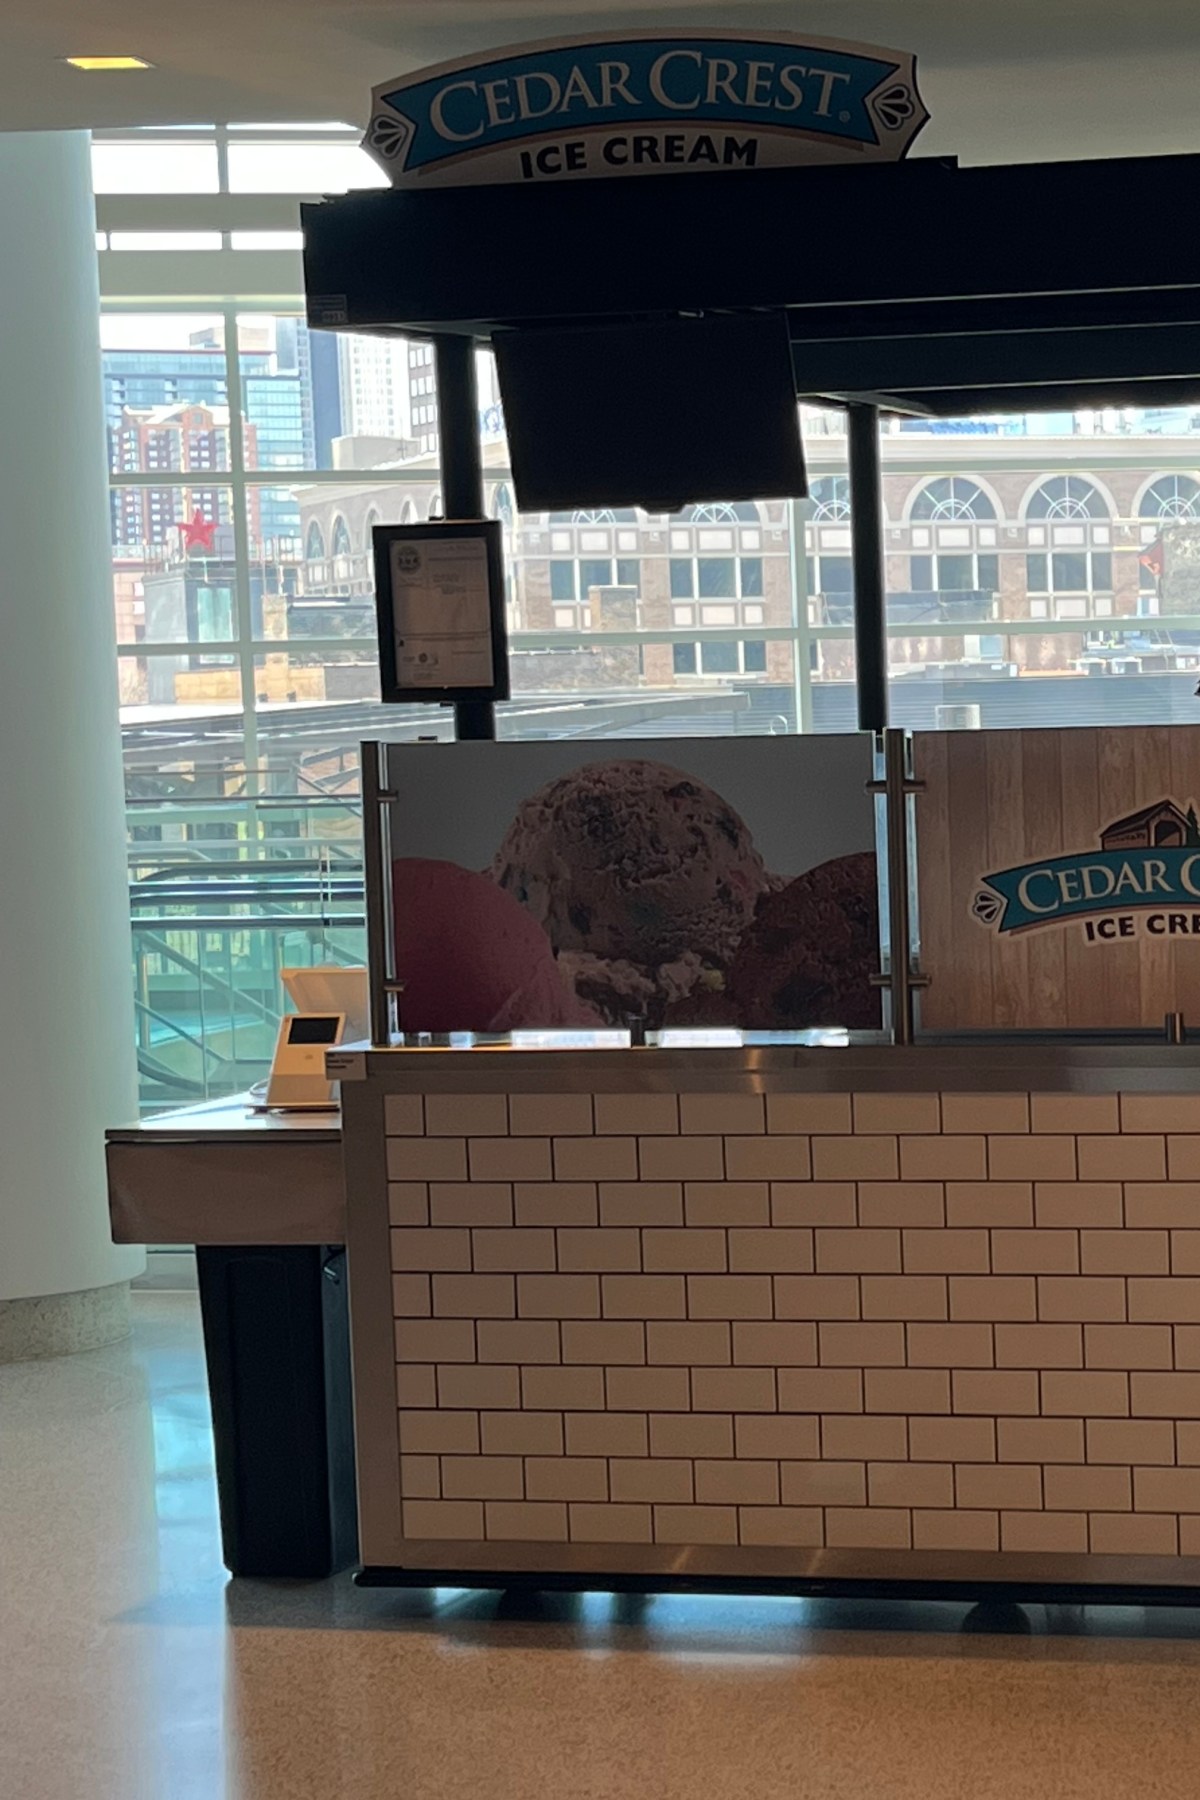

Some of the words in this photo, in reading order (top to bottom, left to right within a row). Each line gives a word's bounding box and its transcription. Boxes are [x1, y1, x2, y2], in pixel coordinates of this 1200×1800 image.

[430, 61, 641, 142] CEDAR
[519, 142, 587, 179] ICE
[603, 134, 758, 167] CREAM
[1018, 859, 1175, 913] CEDAR
[1086, 917, 1135, 941] ICE
